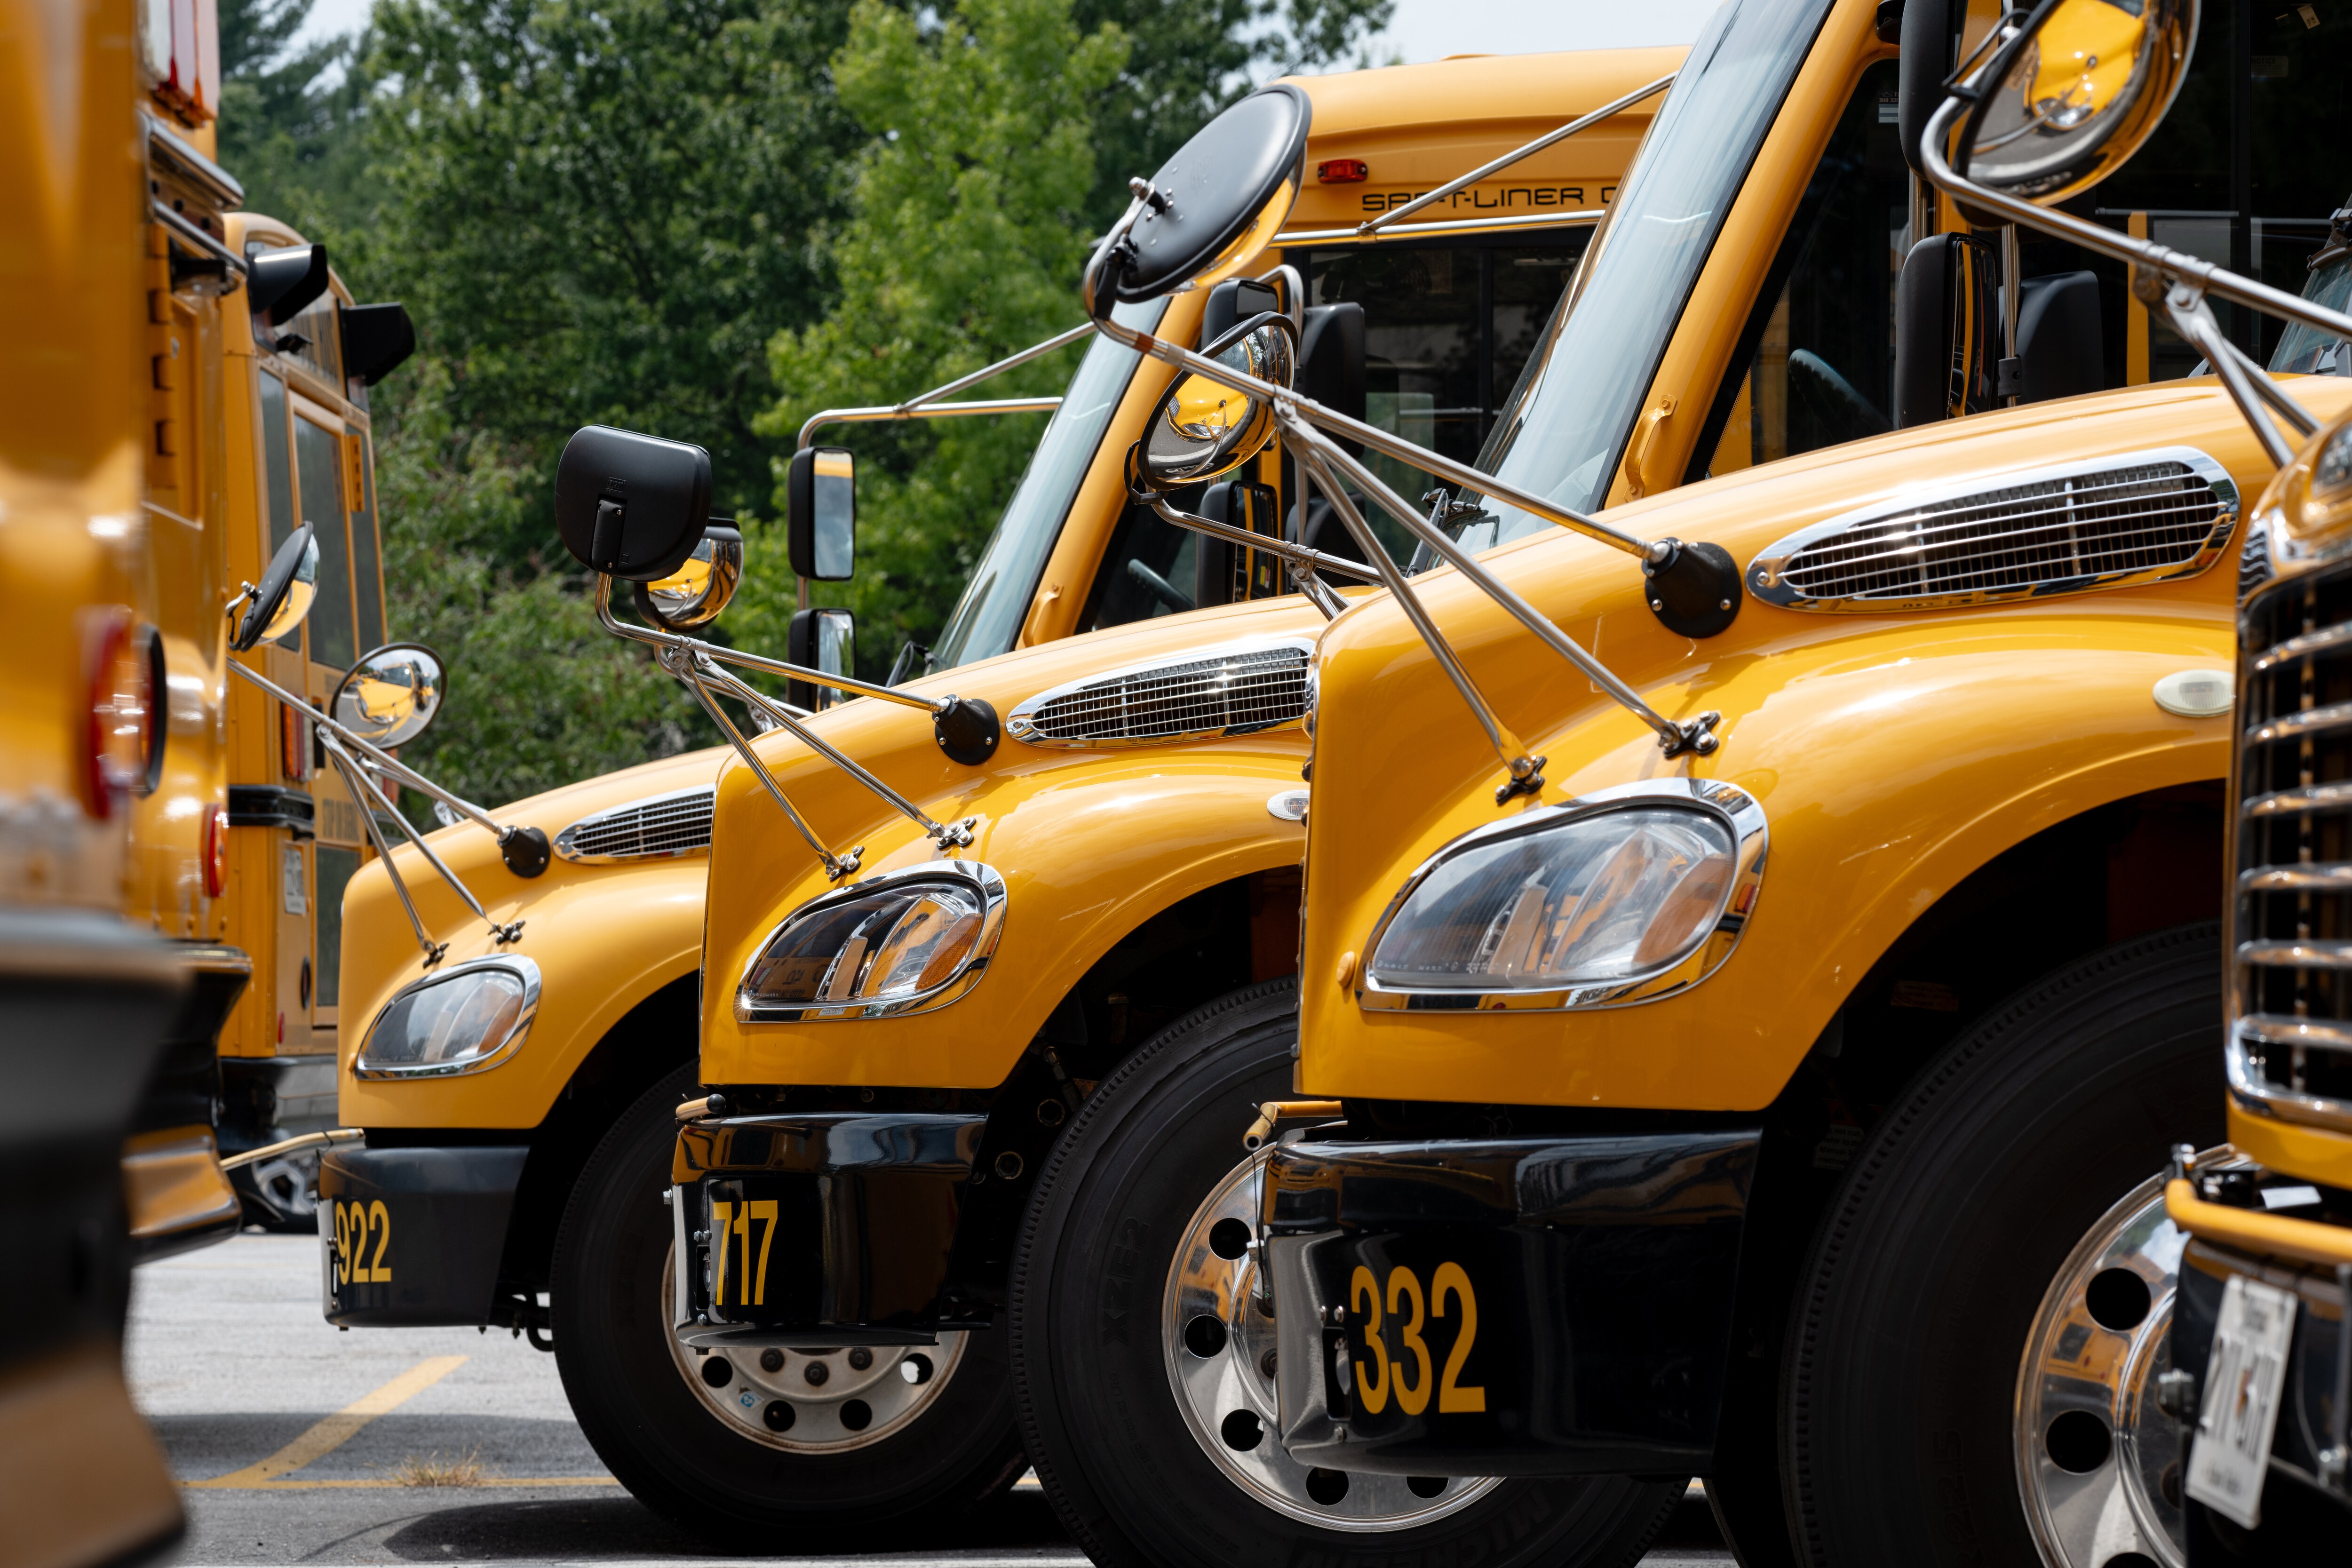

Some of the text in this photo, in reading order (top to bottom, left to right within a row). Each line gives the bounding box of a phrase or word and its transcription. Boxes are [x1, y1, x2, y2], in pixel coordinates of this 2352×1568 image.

[1820, 1146, 1846, 1154] Manual
[336, 1200, 391, 1285] 922
[713, 1200, 778, 1305] 717
[1351, 1261, 1486, 1416] 332
